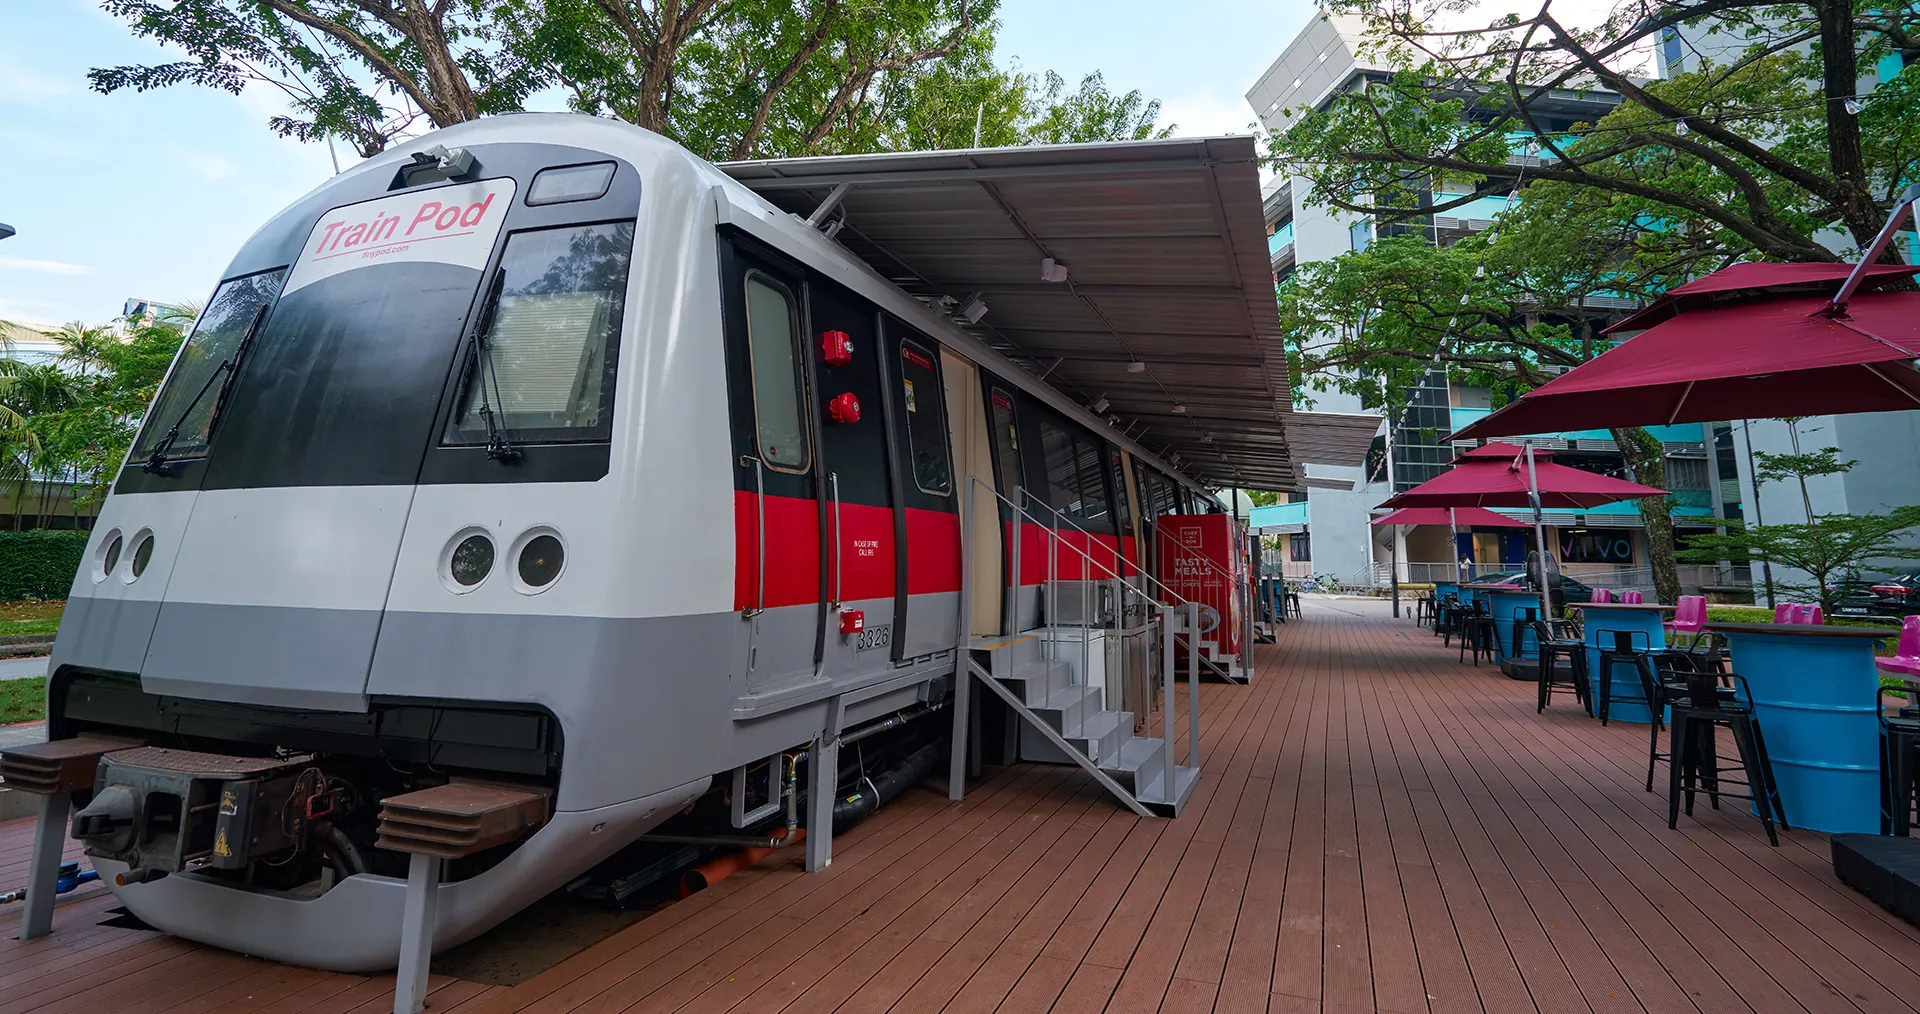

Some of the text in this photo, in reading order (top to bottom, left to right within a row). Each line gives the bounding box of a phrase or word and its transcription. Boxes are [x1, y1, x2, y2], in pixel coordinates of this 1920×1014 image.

[316, 193, 496, 254] Train Pod
[361, 244, 409, 260] tinypod.com
[1561, 538, 1631, 558] VIVO
[1174, 558, 1209, 567] TASTY
[1174, 567, 1212, 576] MEALS
[857, 627, 889, 649] 3326
